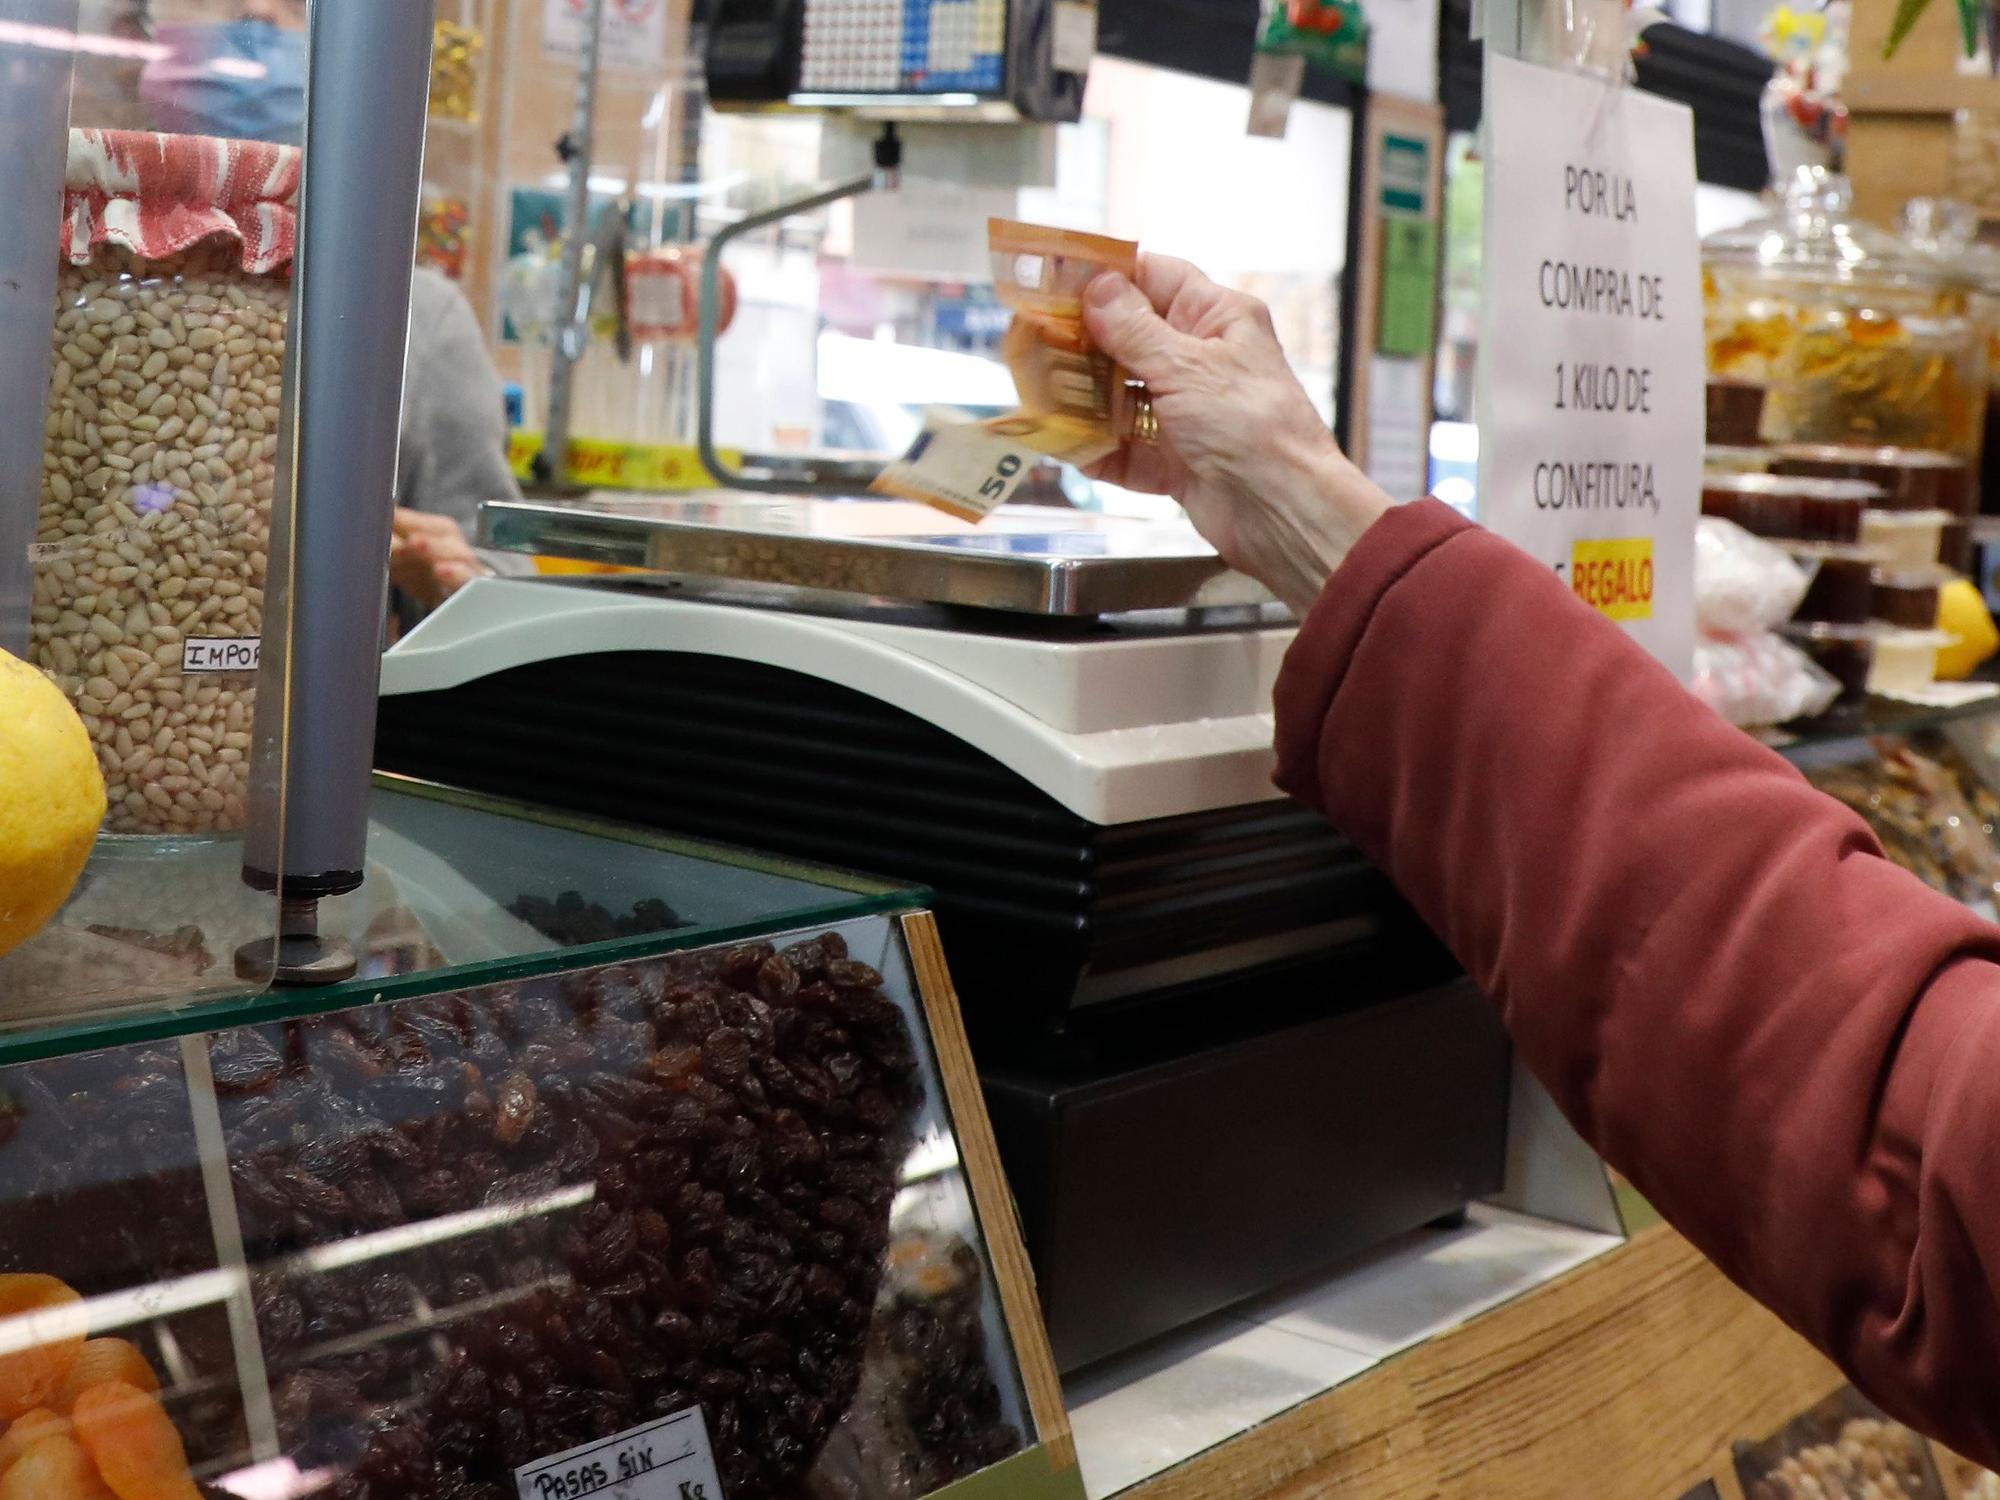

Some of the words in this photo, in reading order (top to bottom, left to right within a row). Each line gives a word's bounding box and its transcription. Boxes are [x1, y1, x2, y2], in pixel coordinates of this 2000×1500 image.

[1565, 165, 1608, 218] POR
[1613, 175, 1638, 223] LA
[1540, 259, 1634, 317] COMPRA
[1638, 274, 1664, 321] DE
[1555, 362, 1565, 409] 1
[1572, 363, 1620, 412] KILO
[1625, 367, 1651, 413] DE
[978, 453, 1022, 500] 50
[1534, 461, 1660, 516] CONFITURA,
[1572, 558, 1653, 606] REGALO
[534, 1461, 608, 1500] PASAS
